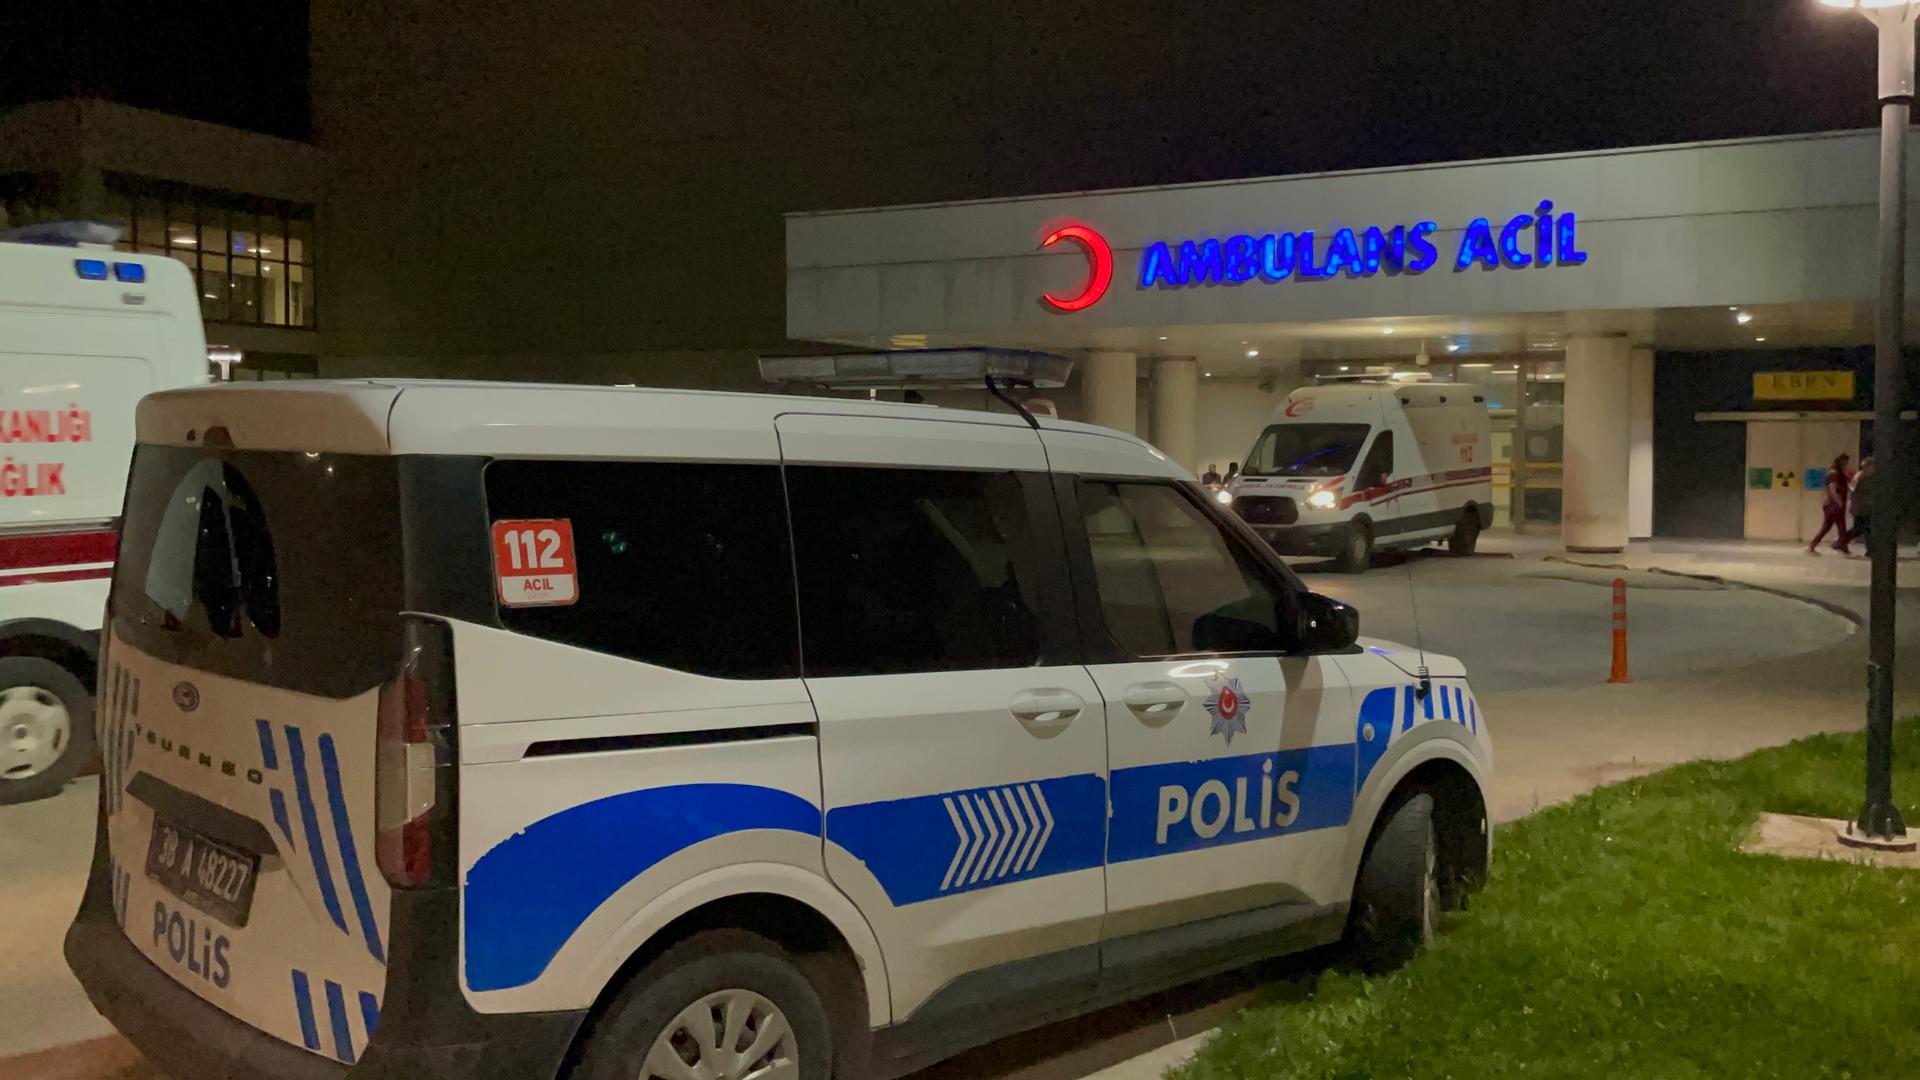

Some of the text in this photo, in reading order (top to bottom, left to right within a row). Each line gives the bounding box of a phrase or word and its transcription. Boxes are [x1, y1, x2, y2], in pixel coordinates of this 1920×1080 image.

[1141, 199, 1587, 288] AMBULANS ACİL
[0, 456, 65, 497] ĞLIK
[504, 529, 564, 569] 112
[134, 723, 263, 785] TOURNEO
[1156, 758, 1300, 844] POLİS
[180, 838, 194, 878] A
[153, 900, 231, 989] POLİS
